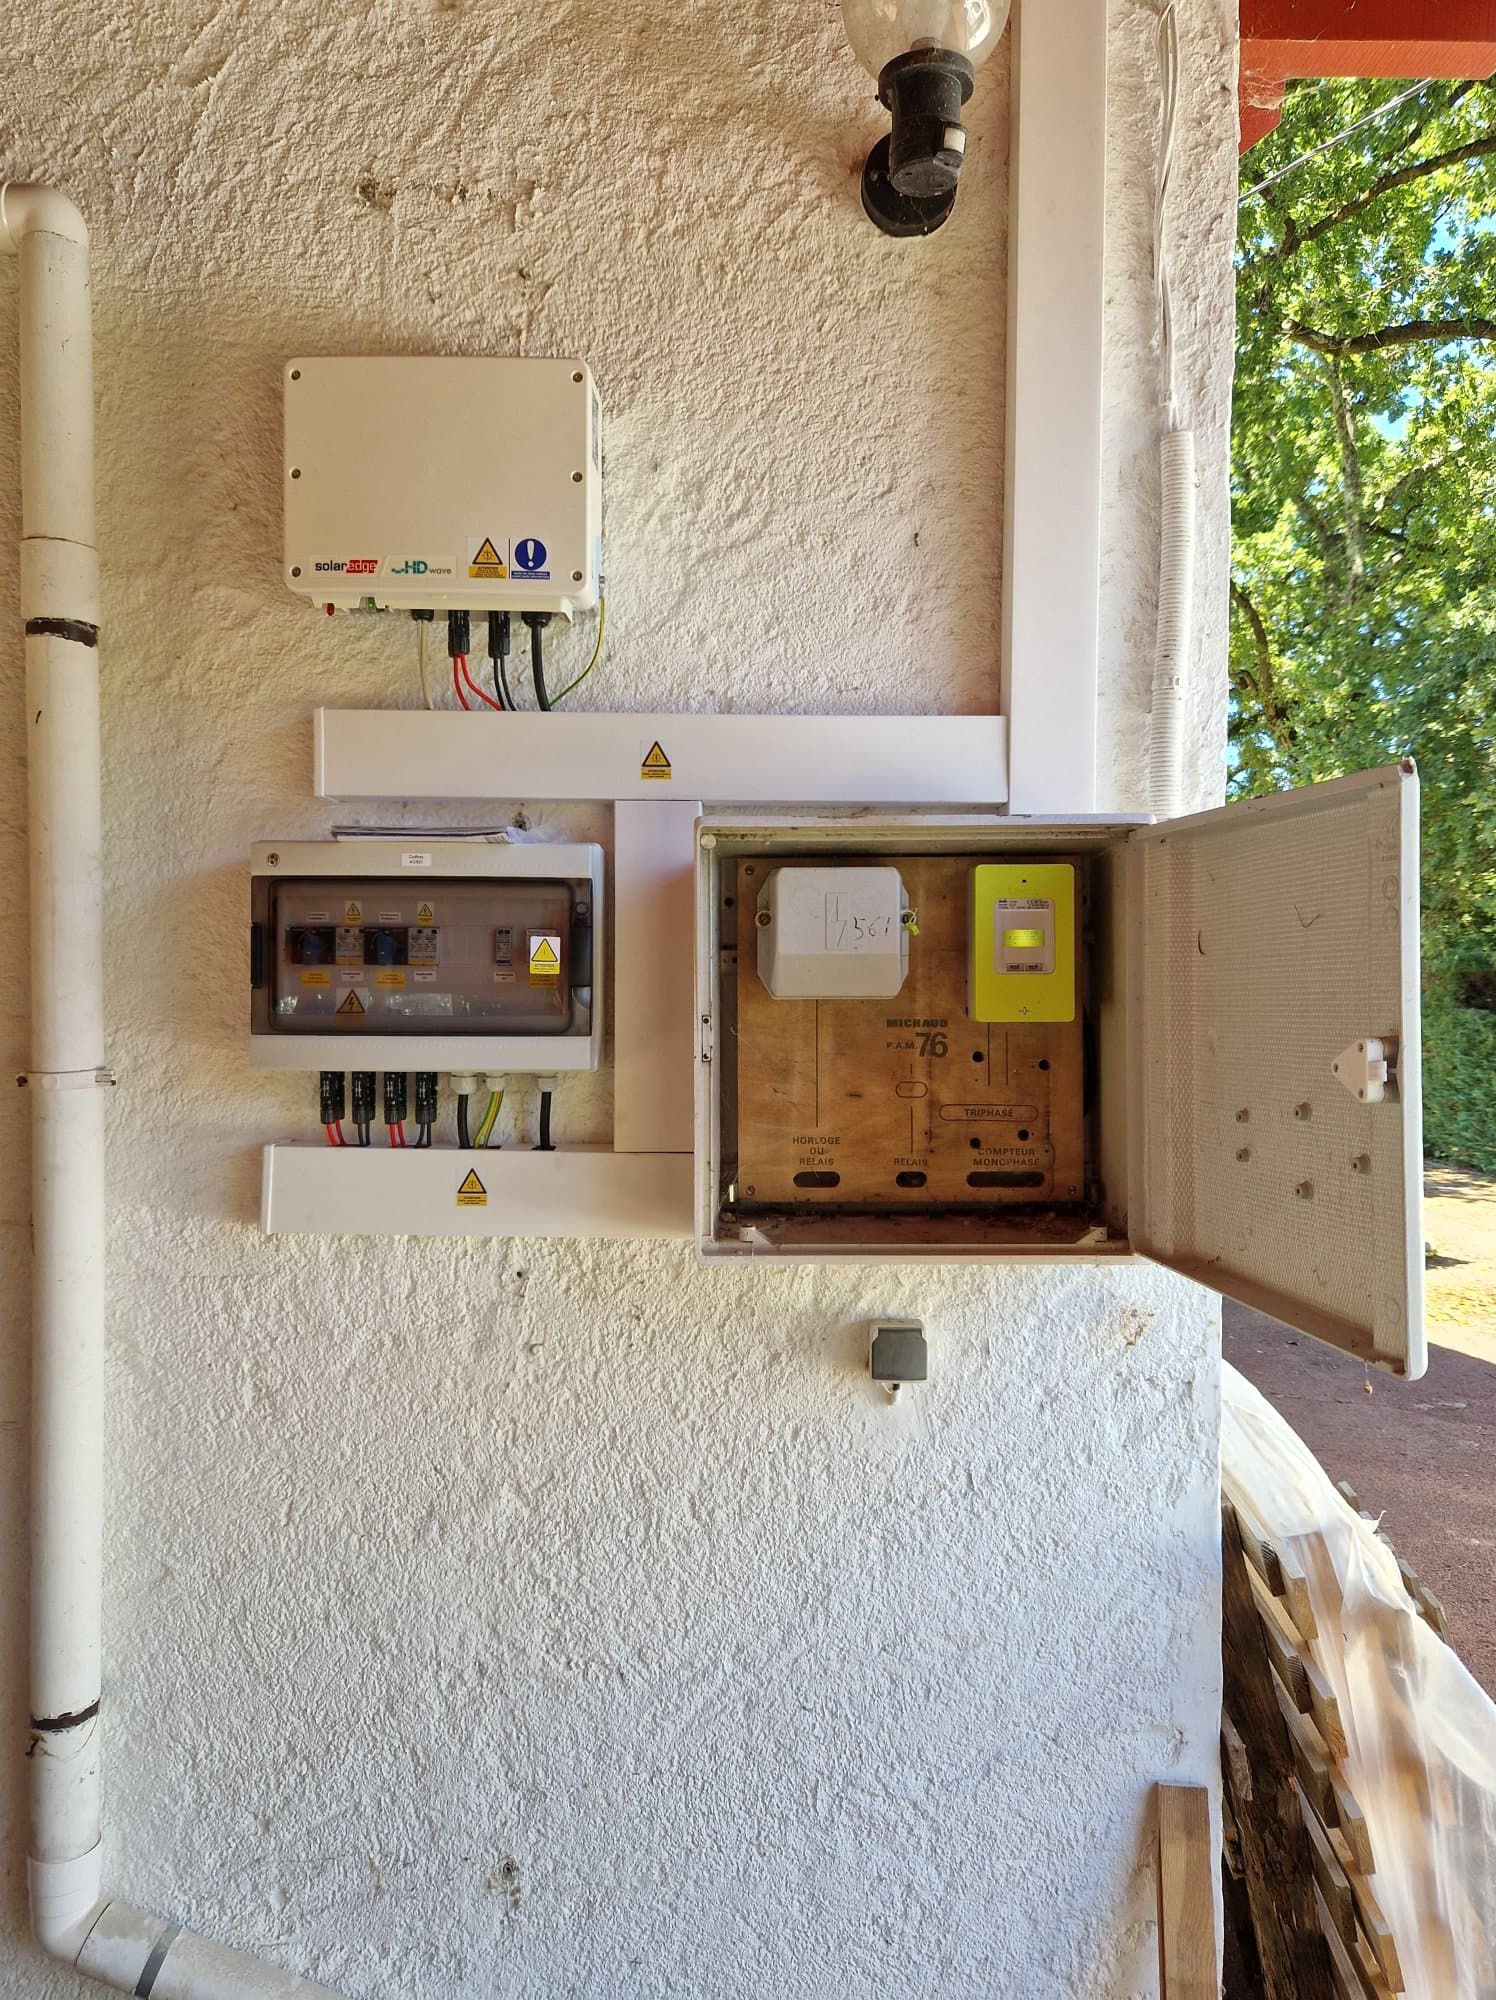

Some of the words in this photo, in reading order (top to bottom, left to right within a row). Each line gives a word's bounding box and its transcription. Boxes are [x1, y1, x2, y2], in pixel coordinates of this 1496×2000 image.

[314, 559, 378, 574] solaredge
[886, 1018, 949, 1029] MICHAUD
[915, 1031, 949, 1058] 76
[792, 1136, 841, 1145] HORLOGE
[809, 1146, 825, 1155] OU
[978, 1147, 1036, 1156] COMPTEUR
[799, 1157, 835, 1166] RELAIS
[893, 1157, 929, 1167] RELAIS
